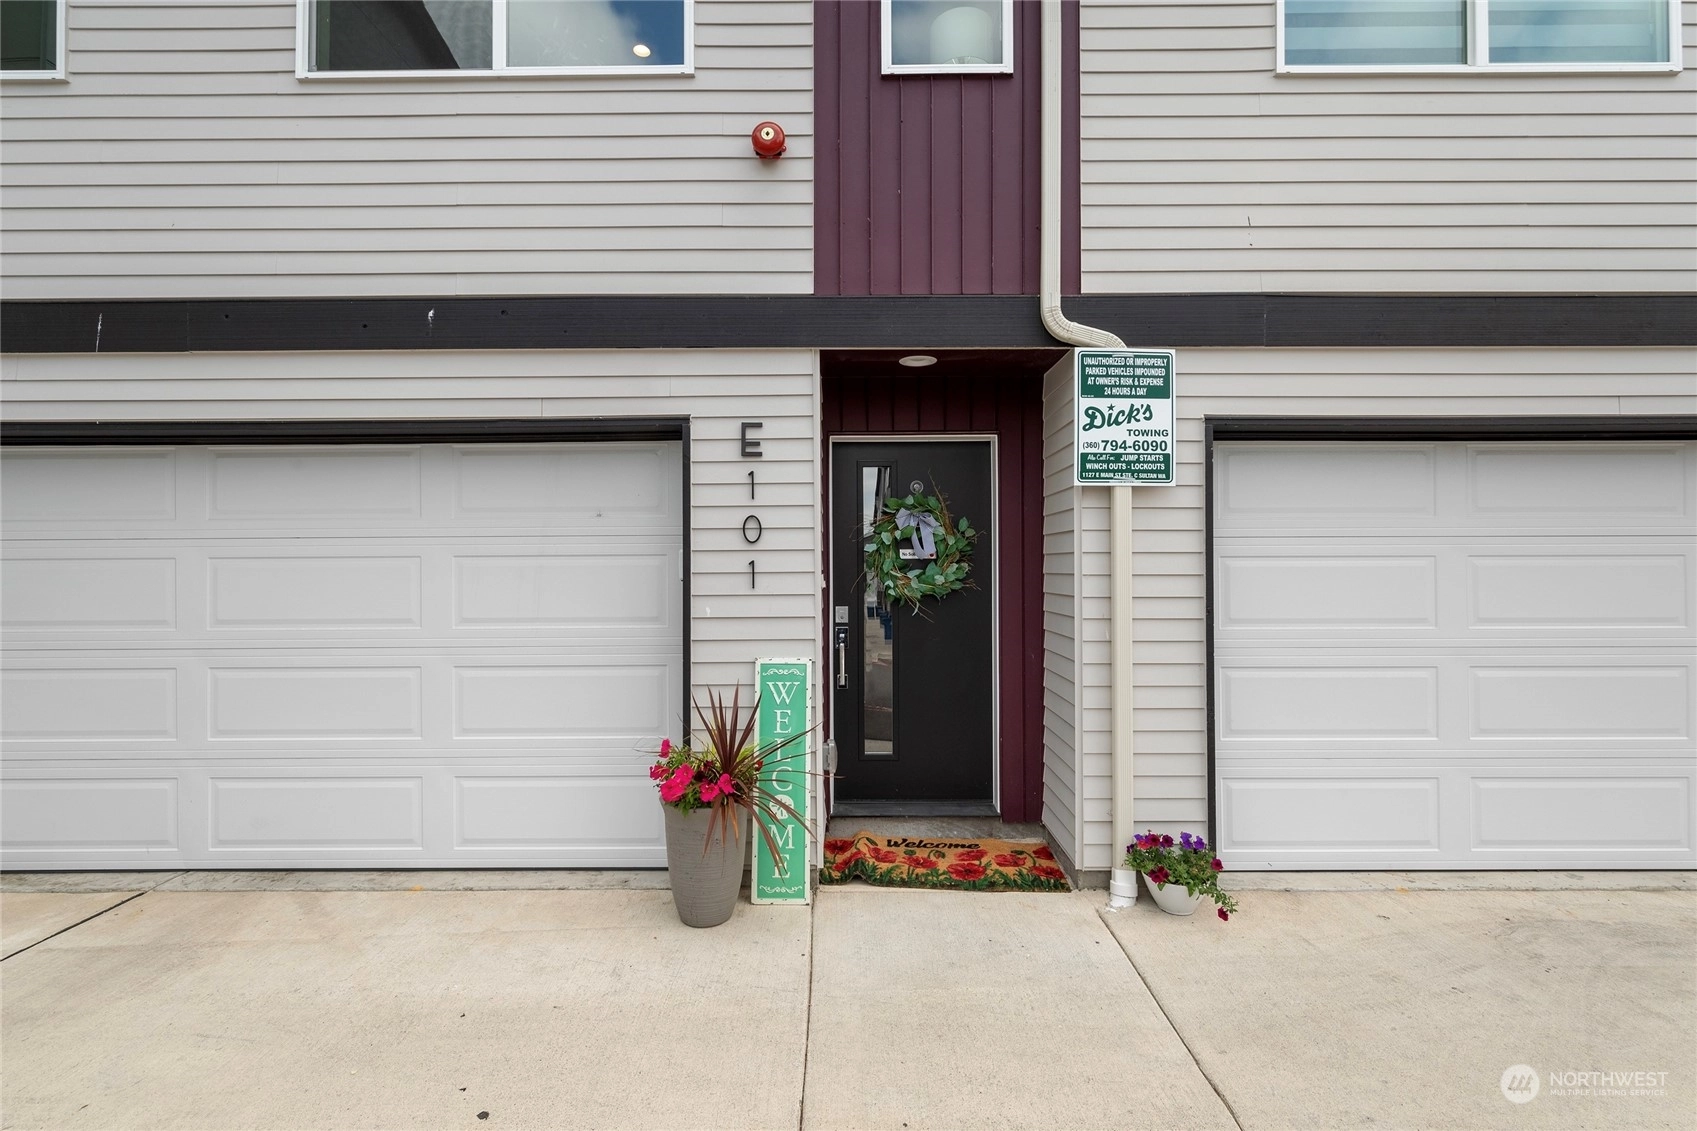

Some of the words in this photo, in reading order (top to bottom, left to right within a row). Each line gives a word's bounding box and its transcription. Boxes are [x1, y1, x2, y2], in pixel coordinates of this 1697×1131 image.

[1083, 357, 1125, 366] UNAUTHORIZED
[1126, 358, 1134, 366] OR
[1134, 358, 1168, 366] IMPROPERLY
[1086, 367, 1107, 375] PARKED
[1108, 368, 1134, 376] VEHICLES
[1134, 368, 1166, 376] IMPOUNDED
[1096, 377, 1119, 385] OWNER'S
[1120, 378, 1134, 386] RISK
[1082, 403, 1153, 432] Dick's
[1082, 441, 1100, 450] (360)
[1101, 440, 1168, 452] 794-6090
[886, 838, 980, 849] Welcome
